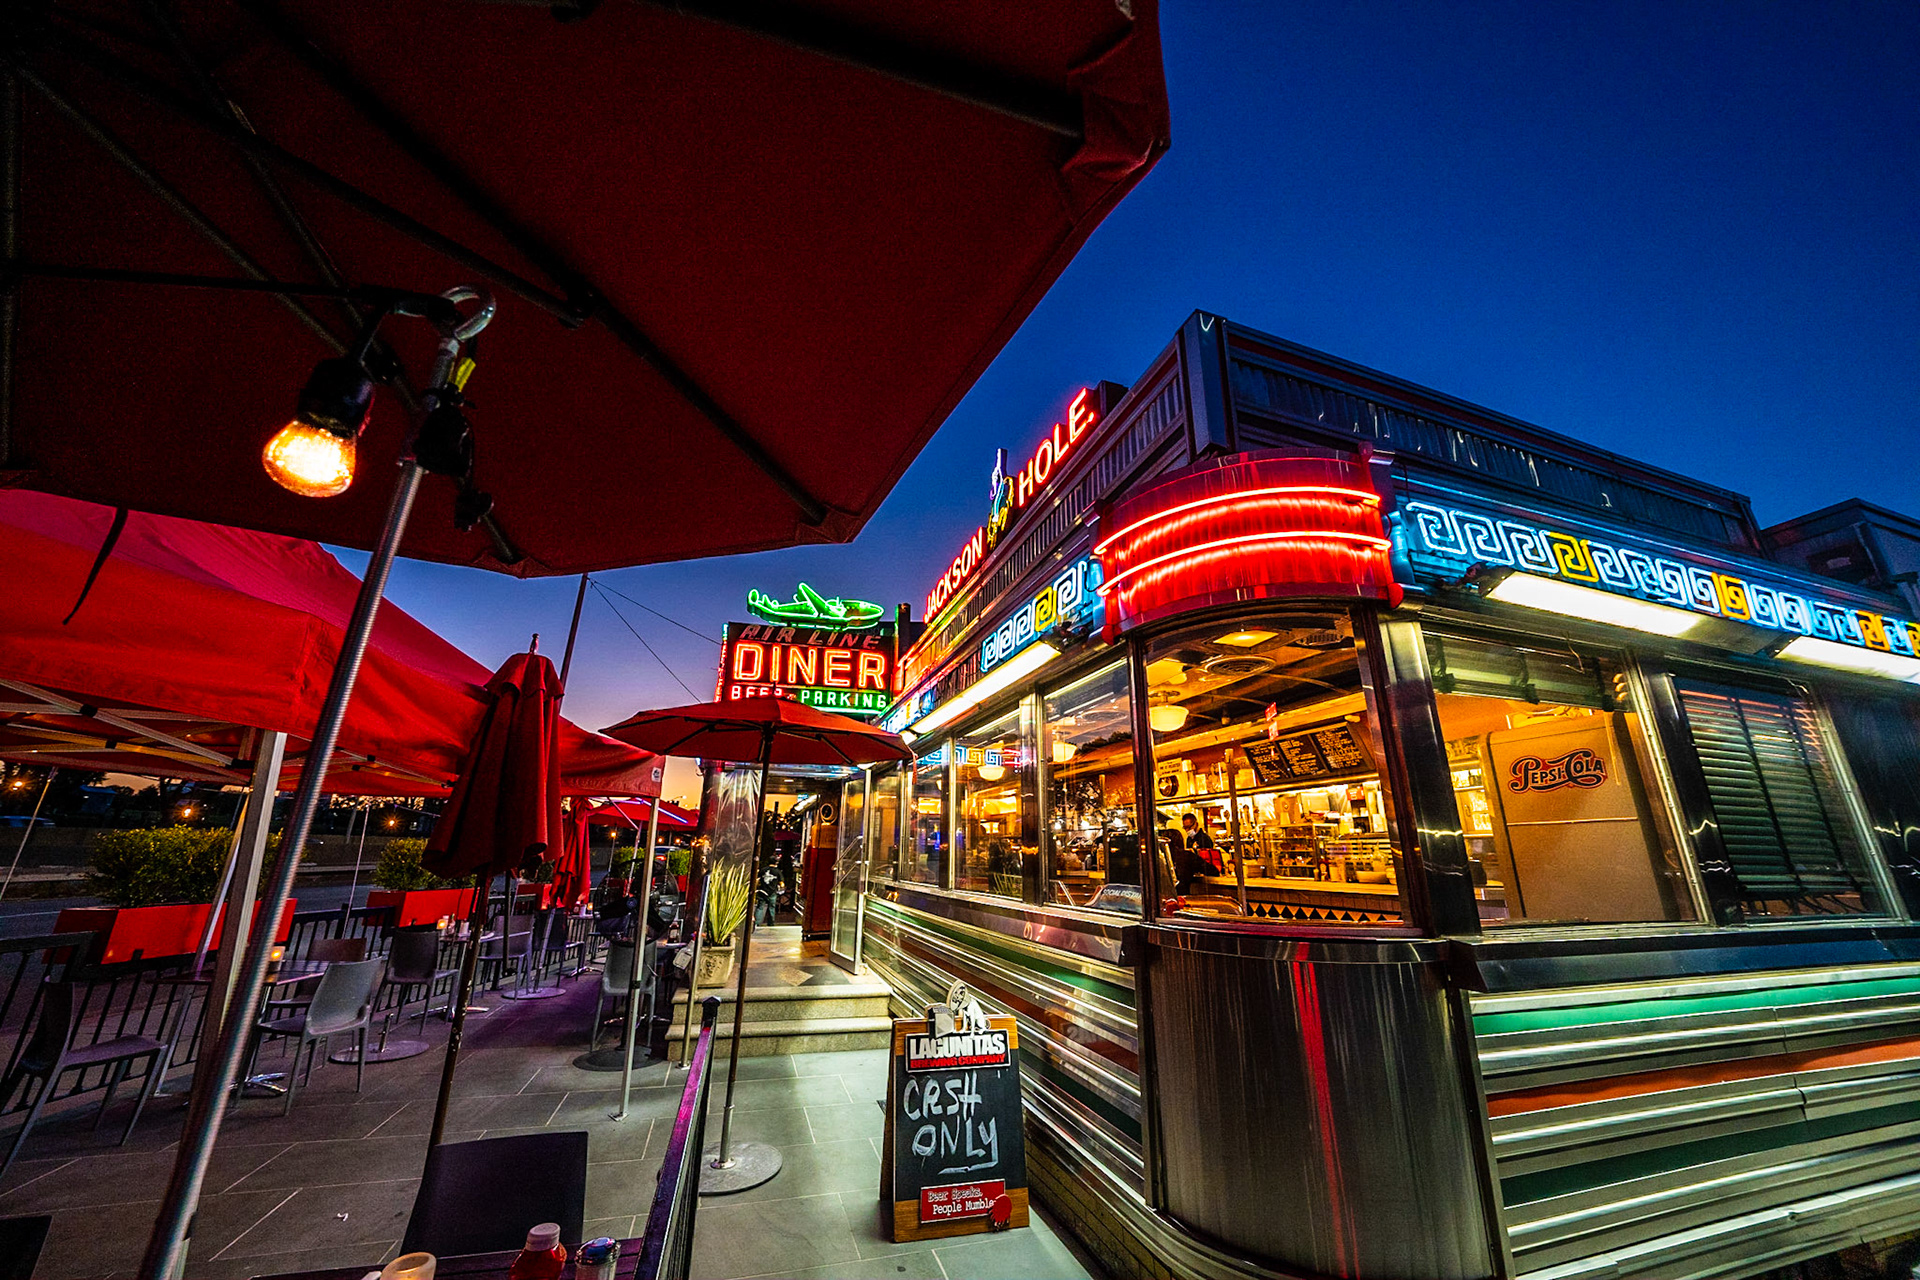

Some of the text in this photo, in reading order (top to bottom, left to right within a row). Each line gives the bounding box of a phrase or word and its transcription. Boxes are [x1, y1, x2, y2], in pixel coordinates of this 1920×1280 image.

[924, 388, 1094, 623] JACKSON HOLE
[739, 625, 882, 649] AIR LINE
[733, 642, 886, 690] DINER
[801, 690, 887, 708] PARKING
[910, 1033, 1005, 1059] LAGUNITAS
[910, 1054, 1005, 1069] BREWING COMPANY
[912, 1115, 998, 1174] ONLY
[928, 1191, 949, 1203] Beer
[932, 1201, 962, 1216] People
